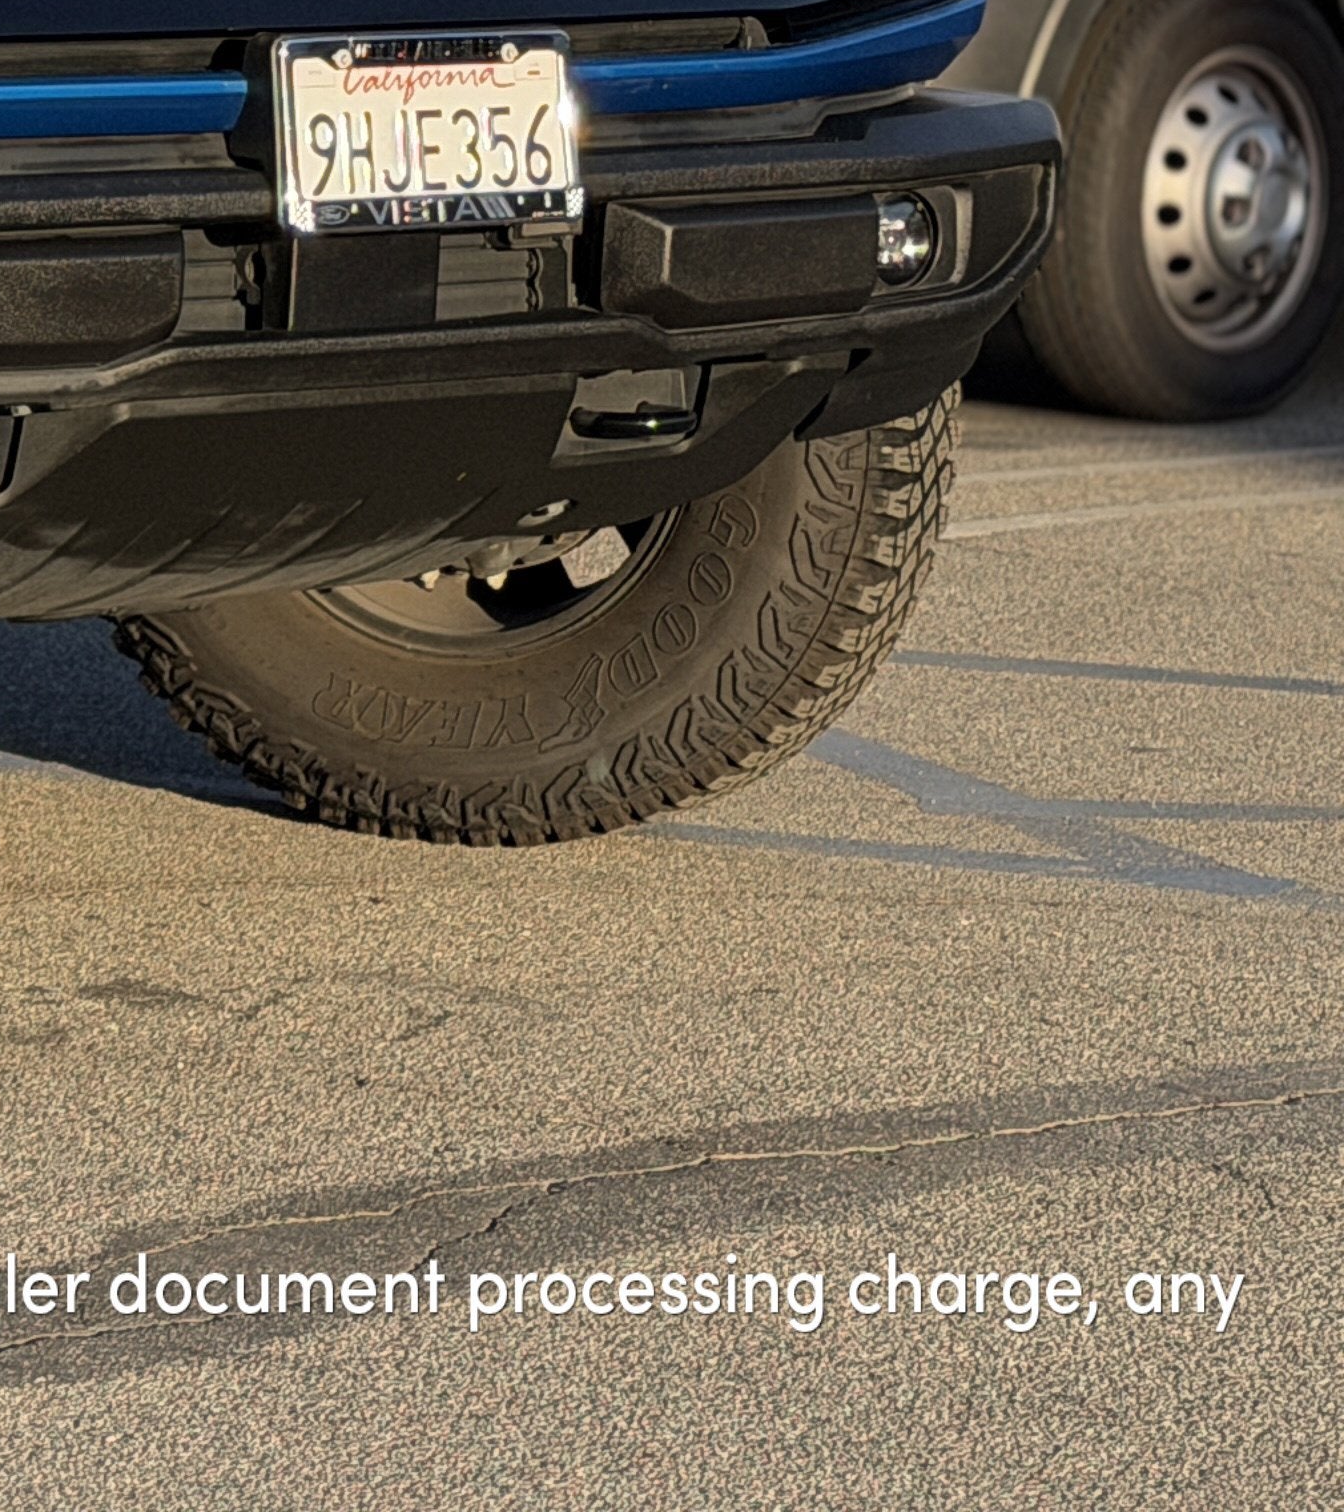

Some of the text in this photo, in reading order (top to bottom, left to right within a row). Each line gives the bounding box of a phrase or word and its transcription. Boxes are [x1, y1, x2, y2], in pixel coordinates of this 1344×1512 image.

[342, 65, 515, 103] California
[307, 104, 553, 196] 9HJE356
[367, 197, 483, 225] VISTA
